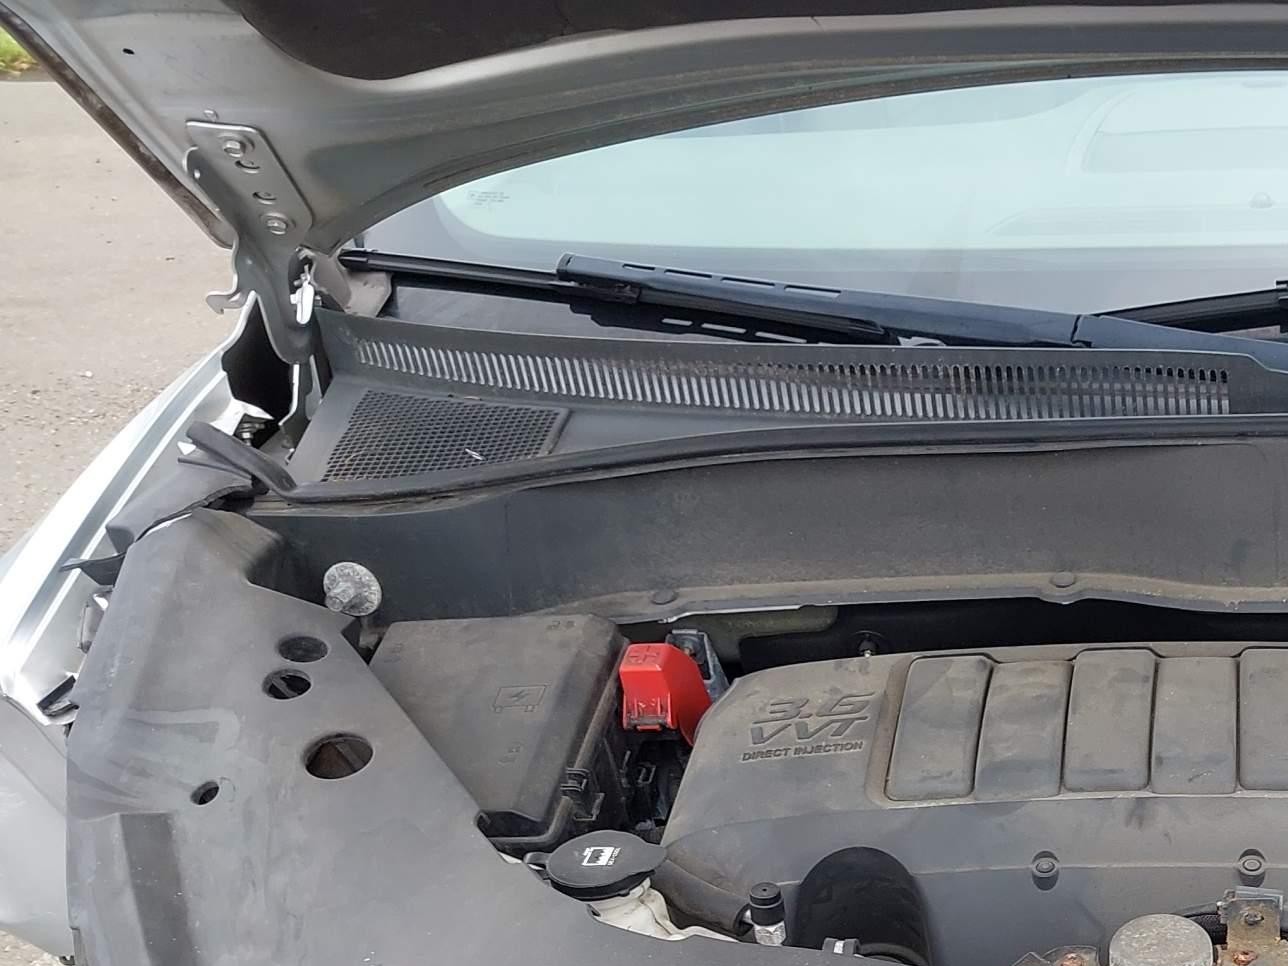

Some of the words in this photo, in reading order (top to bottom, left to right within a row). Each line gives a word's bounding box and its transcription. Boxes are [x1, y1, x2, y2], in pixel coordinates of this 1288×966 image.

[753, 692, 876, 725] 3.6
[750, 715, 869, 746] VVT
[742, 747, 792, 762] DIRECT
[793, 741, 864, 757] INJECTION
